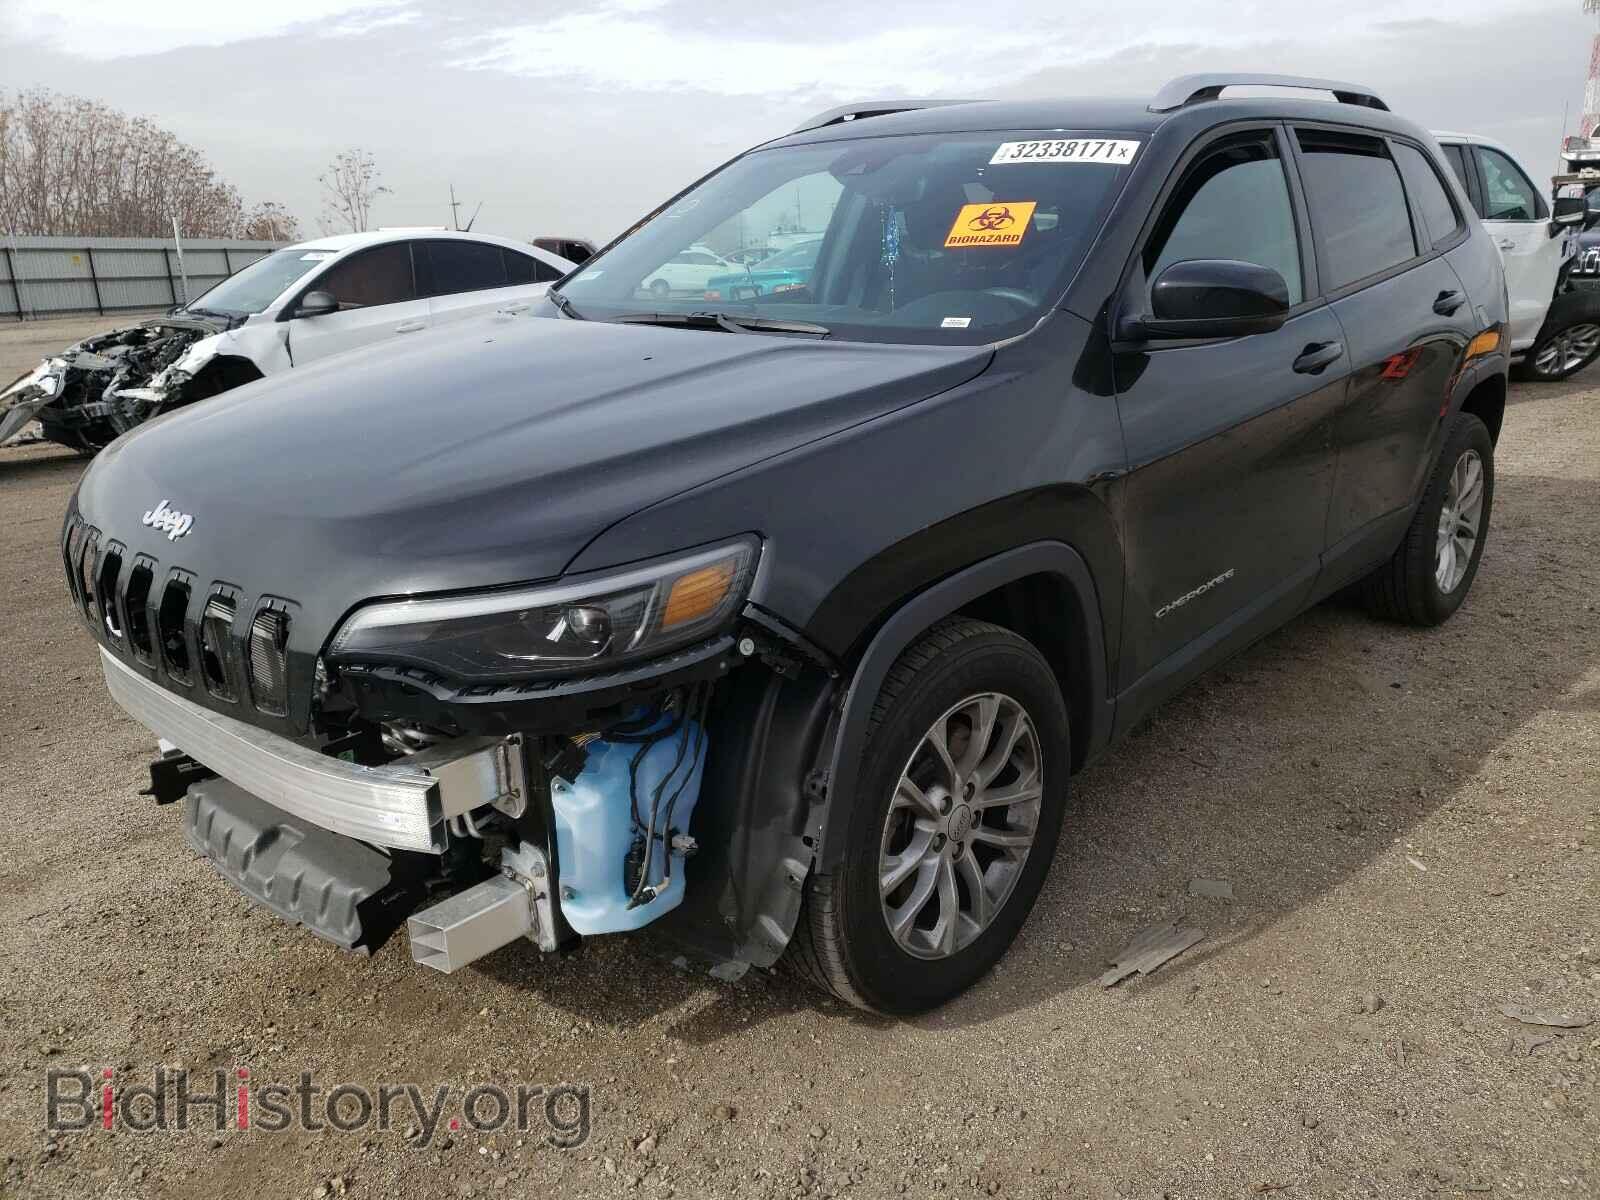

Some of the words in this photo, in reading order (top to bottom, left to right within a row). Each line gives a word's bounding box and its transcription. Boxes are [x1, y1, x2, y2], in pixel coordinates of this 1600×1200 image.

[1010, 141, 1117, 158] 32338171
[948, 234, 1020, 245] BIOHAZARD
[142, 499, 193, 541] Jeep
[1155, 568, 1235, 618] CHEROKEE
